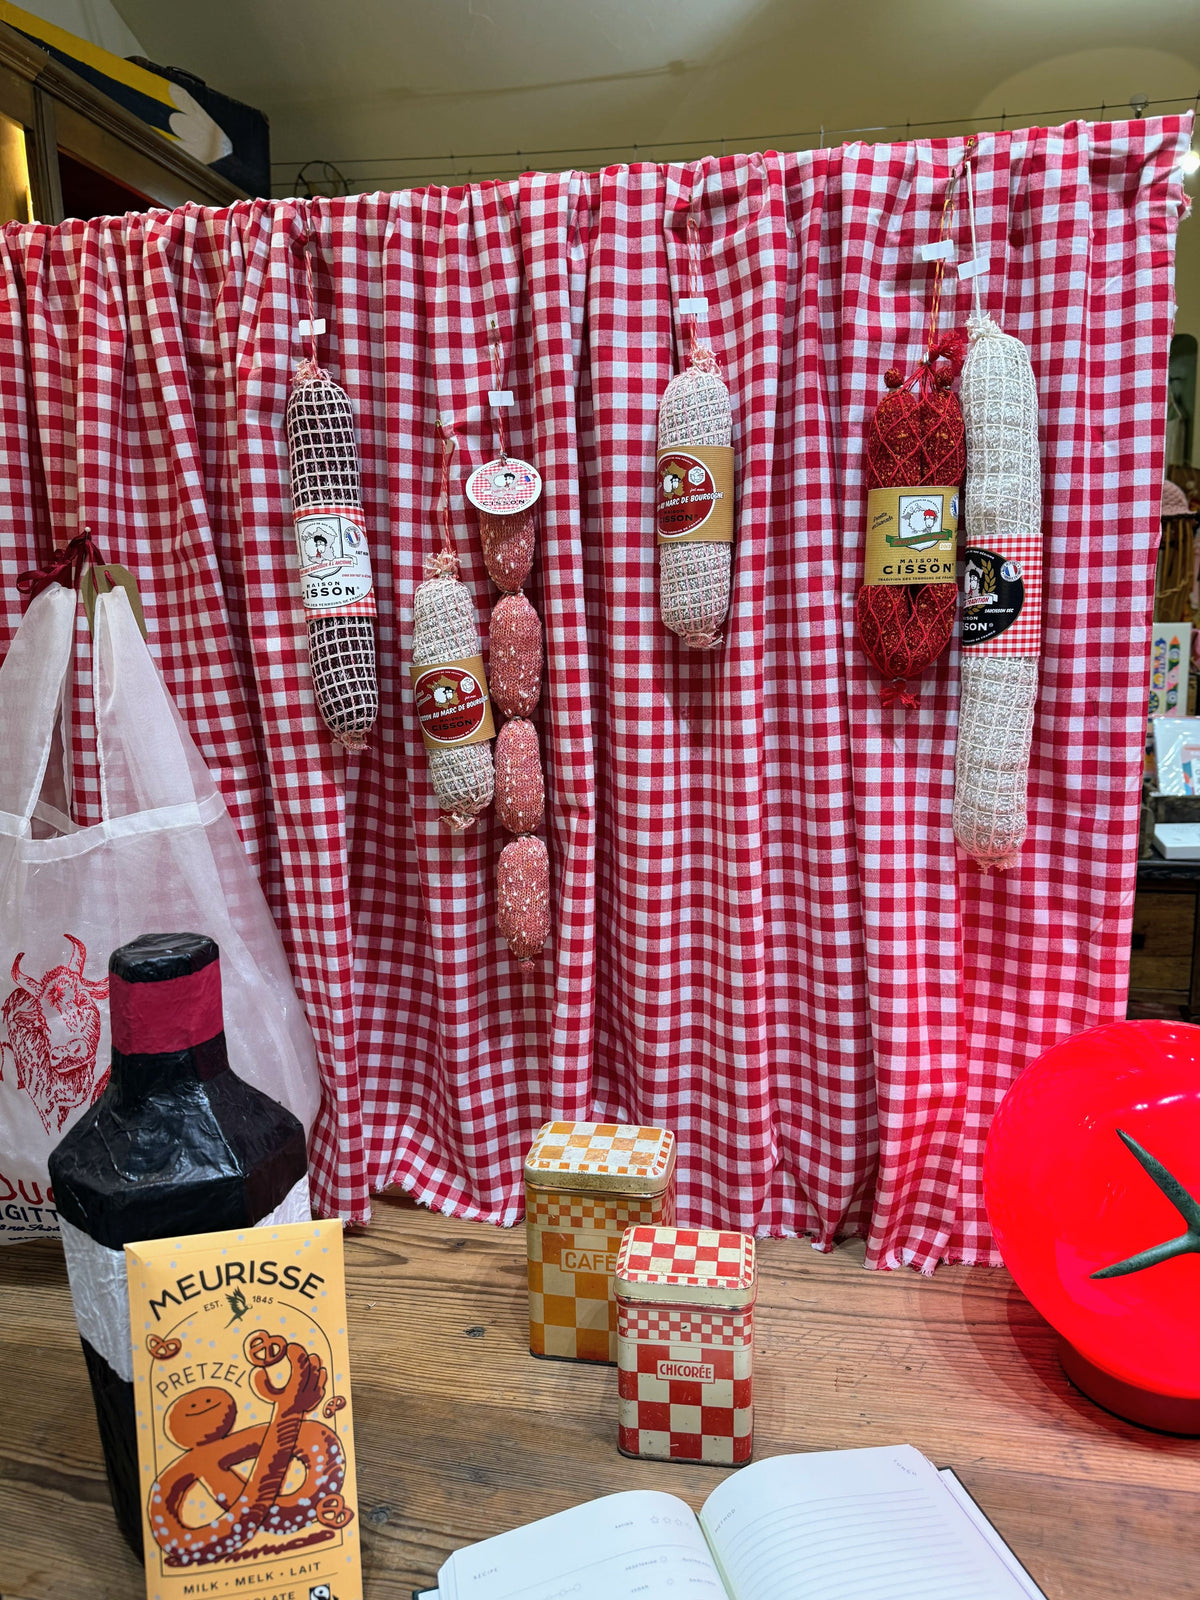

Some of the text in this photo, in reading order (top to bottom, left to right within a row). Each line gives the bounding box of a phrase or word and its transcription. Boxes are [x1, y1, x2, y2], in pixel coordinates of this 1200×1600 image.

[882, 563, 952, 575] CISSON
[440, 706, 457, 717] MARC
[458, 704, 466, 712] DE
[432, 719, 472, 731] CISSON
[149, 1260, 325, 1322] MEURISSE
[203, 1295, 274, 1312] EST. 1845
[659, 1362, 712, 1380] CHICORÉE
[156, 1362, 247, 1398] PRETZEL
[183, 1561, 321, 1594] MILK MELK LAIT
